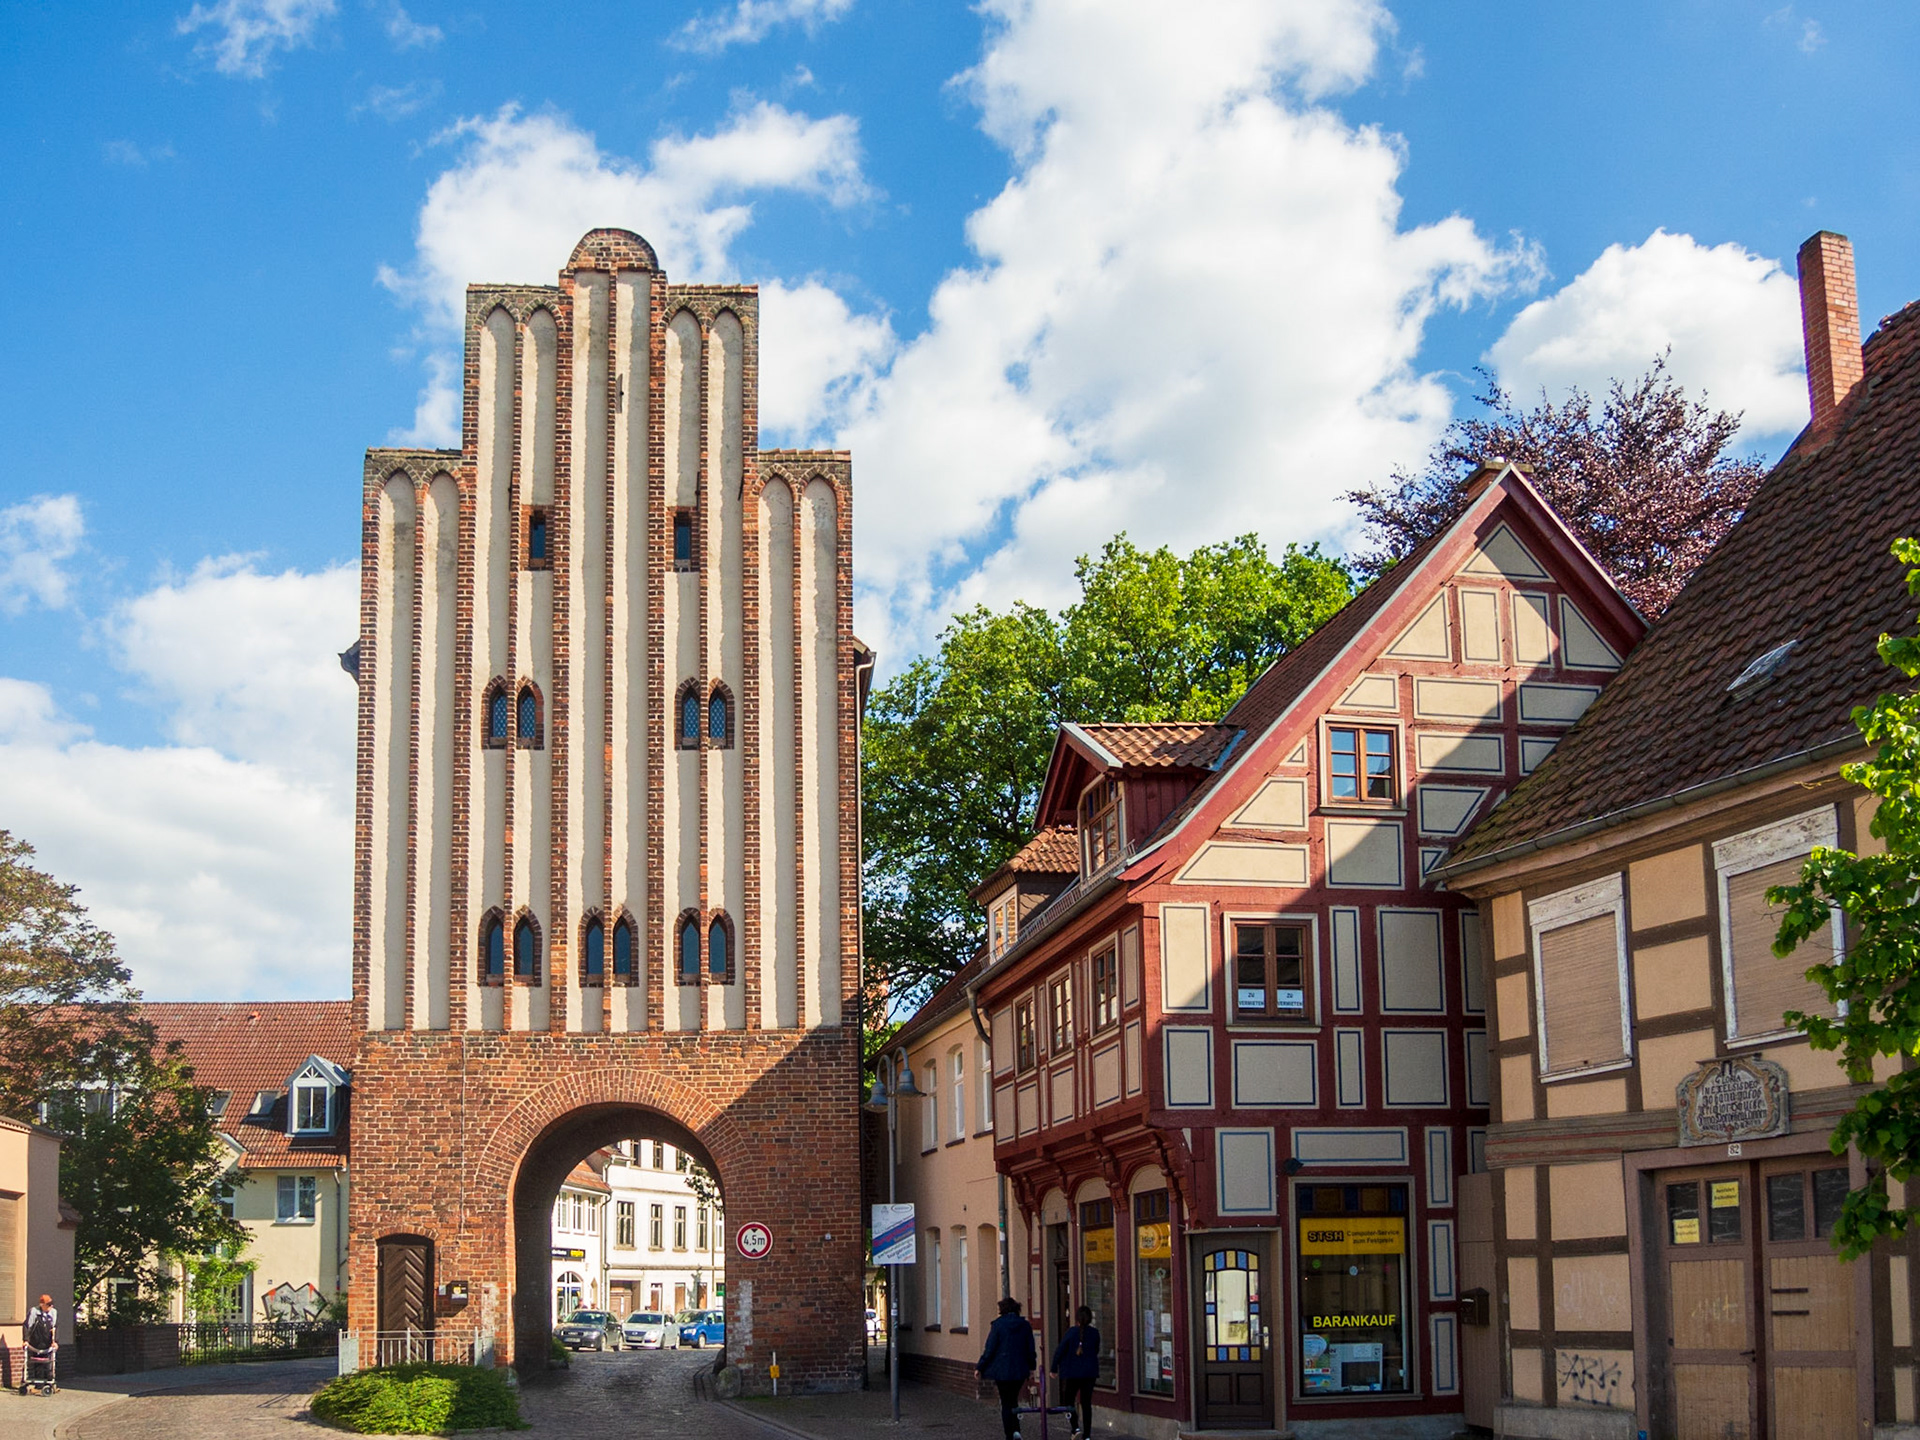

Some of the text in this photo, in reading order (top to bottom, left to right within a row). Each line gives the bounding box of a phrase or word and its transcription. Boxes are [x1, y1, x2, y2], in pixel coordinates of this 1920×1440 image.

[1730, 1144, 1739, 1154] 82
[1307, 1230, 1344, 1243] STSH
[1312, 1314, 1396, 1328] BARANKAUF
